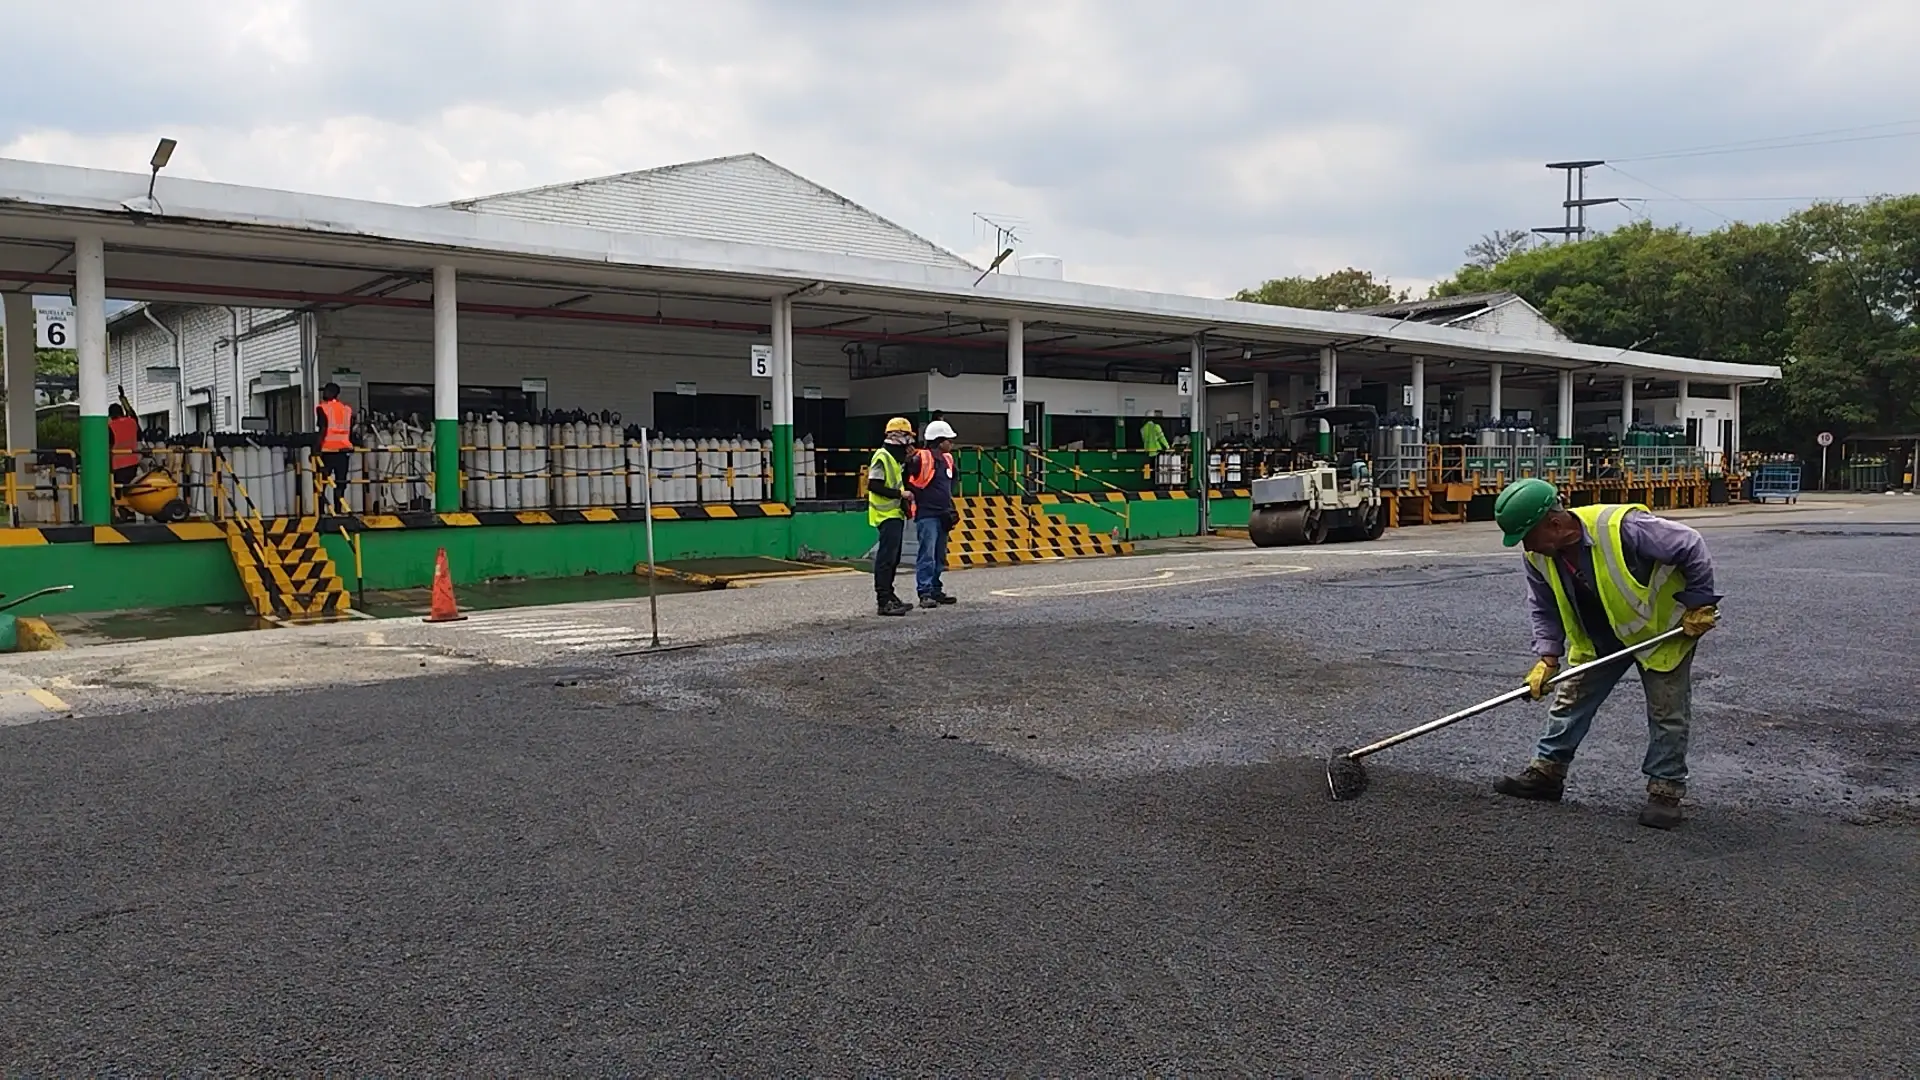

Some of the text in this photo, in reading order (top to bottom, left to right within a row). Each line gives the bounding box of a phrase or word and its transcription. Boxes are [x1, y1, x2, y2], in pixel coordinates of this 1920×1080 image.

[47, 322, 66, 346] 6
[757, 358, 766, 374] 5
[1181, 381, 1188, 394] 4
